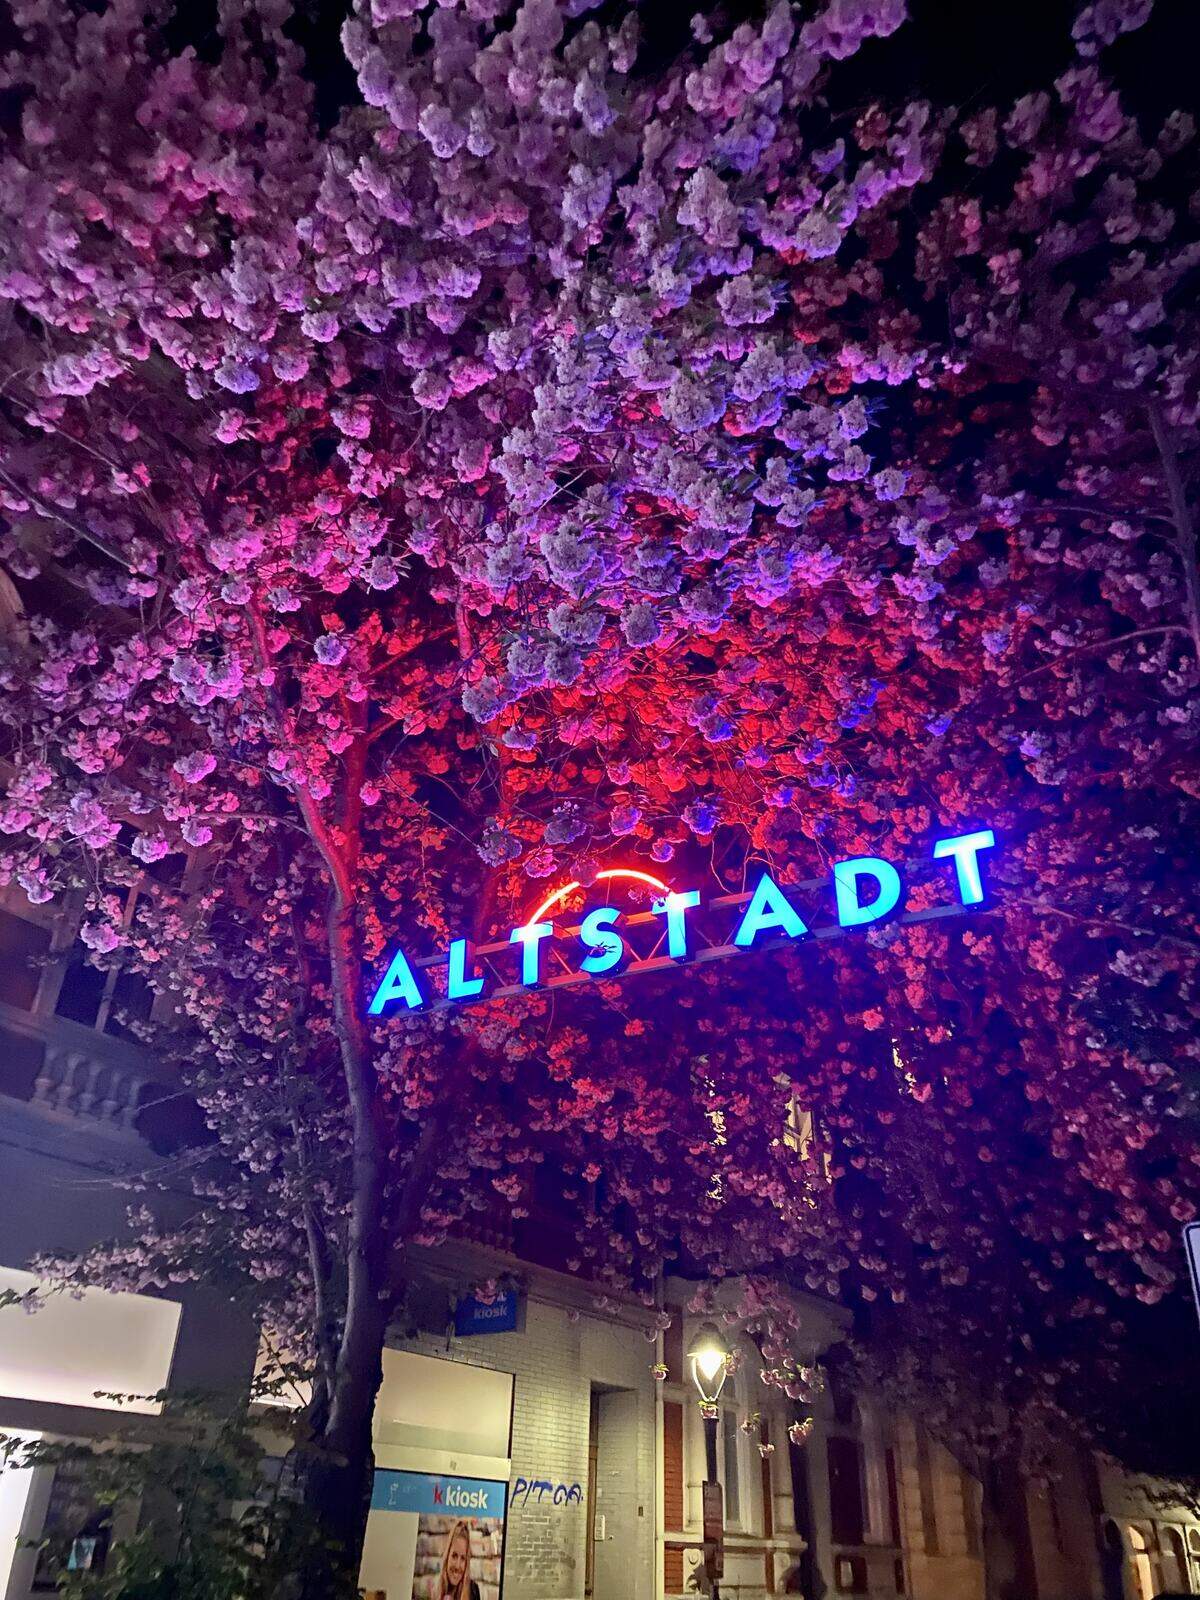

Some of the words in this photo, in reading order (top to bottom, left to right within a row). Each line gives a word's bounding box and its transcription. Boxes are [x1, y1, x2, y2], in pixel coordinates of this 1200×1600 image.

[367, 830, 995, 1015] ALTSTADT
[473, 1304, 508, 1320] kiosk
[445, 1485, 488, 1509] kiosk
